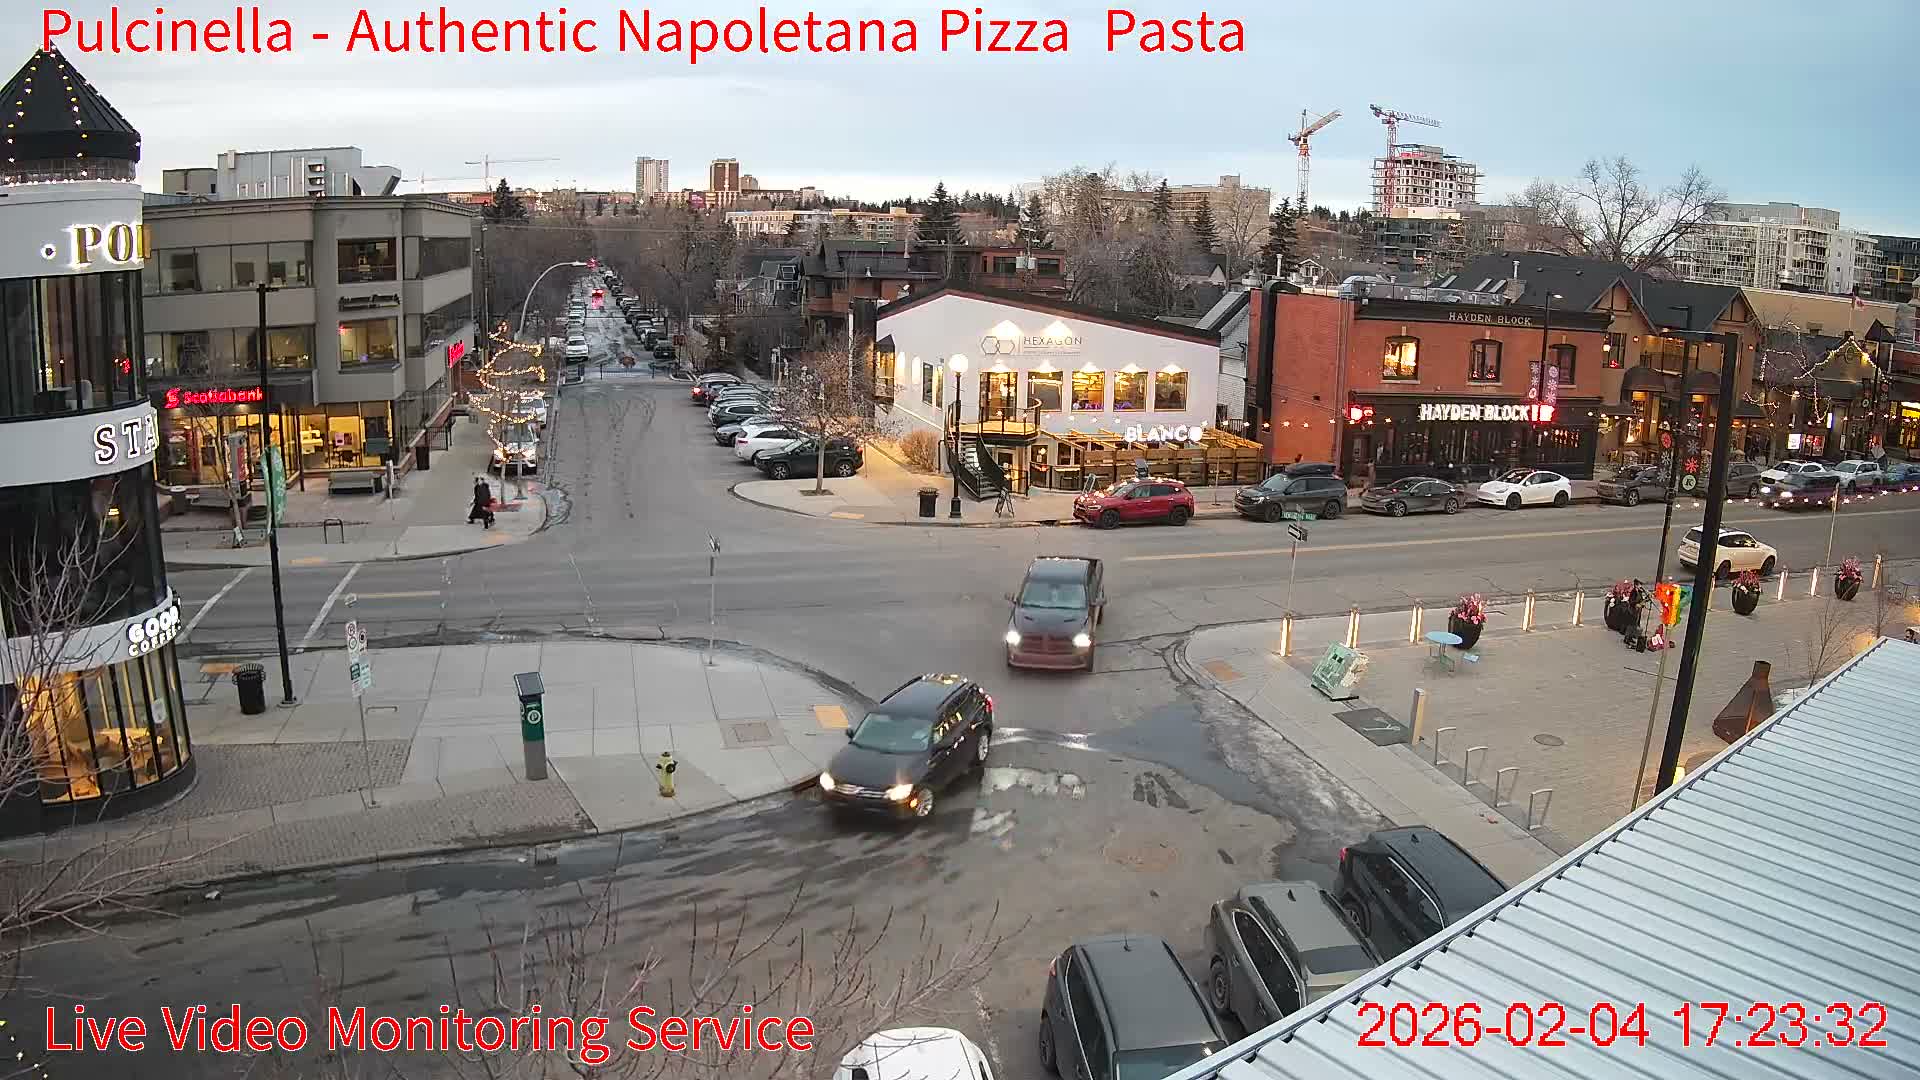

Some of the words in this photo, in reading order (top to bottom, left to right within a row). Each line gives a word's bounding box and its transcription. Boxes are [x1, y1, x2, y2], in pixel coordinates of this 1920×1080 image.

[1449, 312, 1491, 322] HAYDEN
[1498, 315, 1532, 326] BLOCK
[1024, 336, 1082, 346] HEXAGON
[183, 386, 263, 405] Scotiabank
[1420, 403, 1481, 421] HAYDEN
[1484, 404, 1529, 421] BLOCK
[1124, 424, 1203, 443] BLANCO
